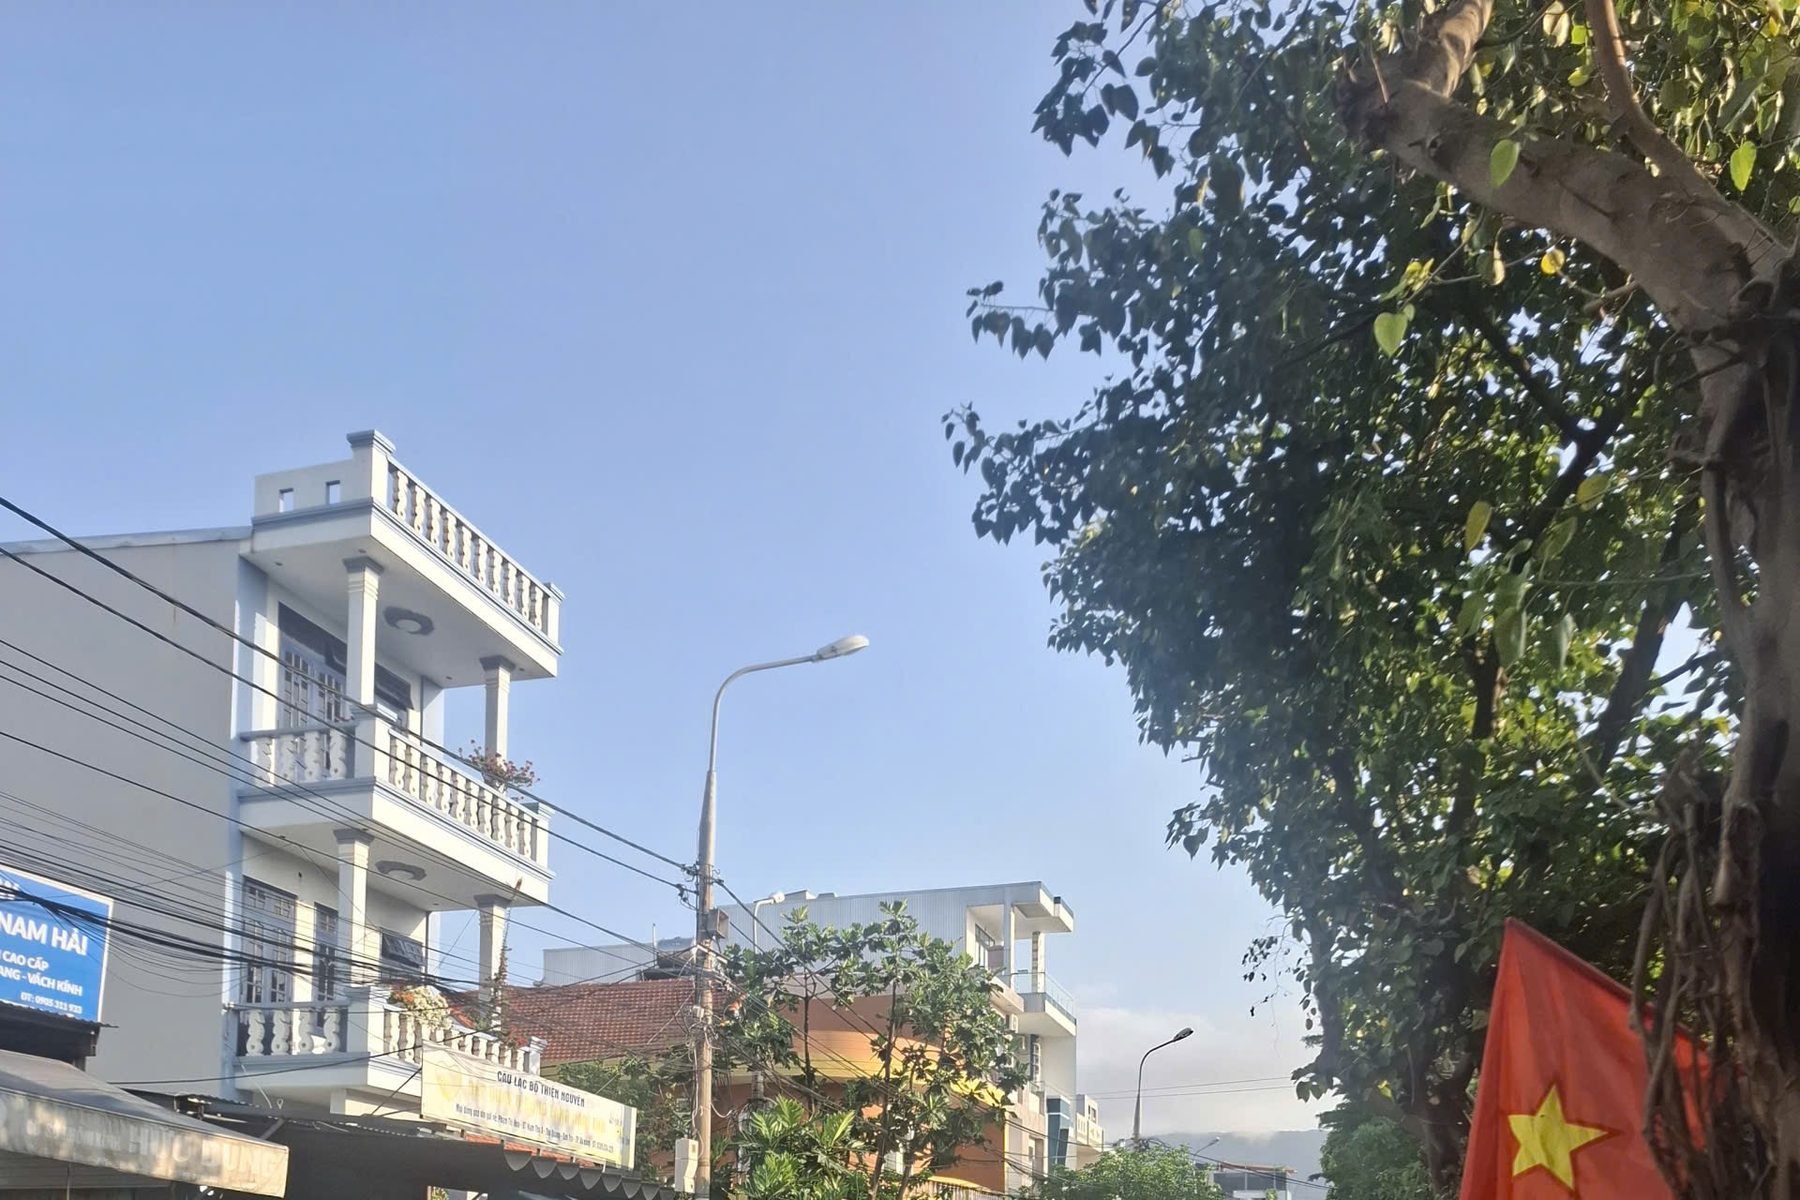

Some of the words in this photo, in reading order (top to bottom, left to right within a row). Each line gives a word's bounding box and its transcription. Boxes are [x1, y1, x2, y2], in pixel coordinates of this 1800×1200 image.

[0, 910, 48, 945] NAM
[3, 951, 26, 966] CAO
[27, 956, 49, 971] CẤP
[28, 970, 56, 990] VÁCH
[57, 979, 83, 997] KÍNH
